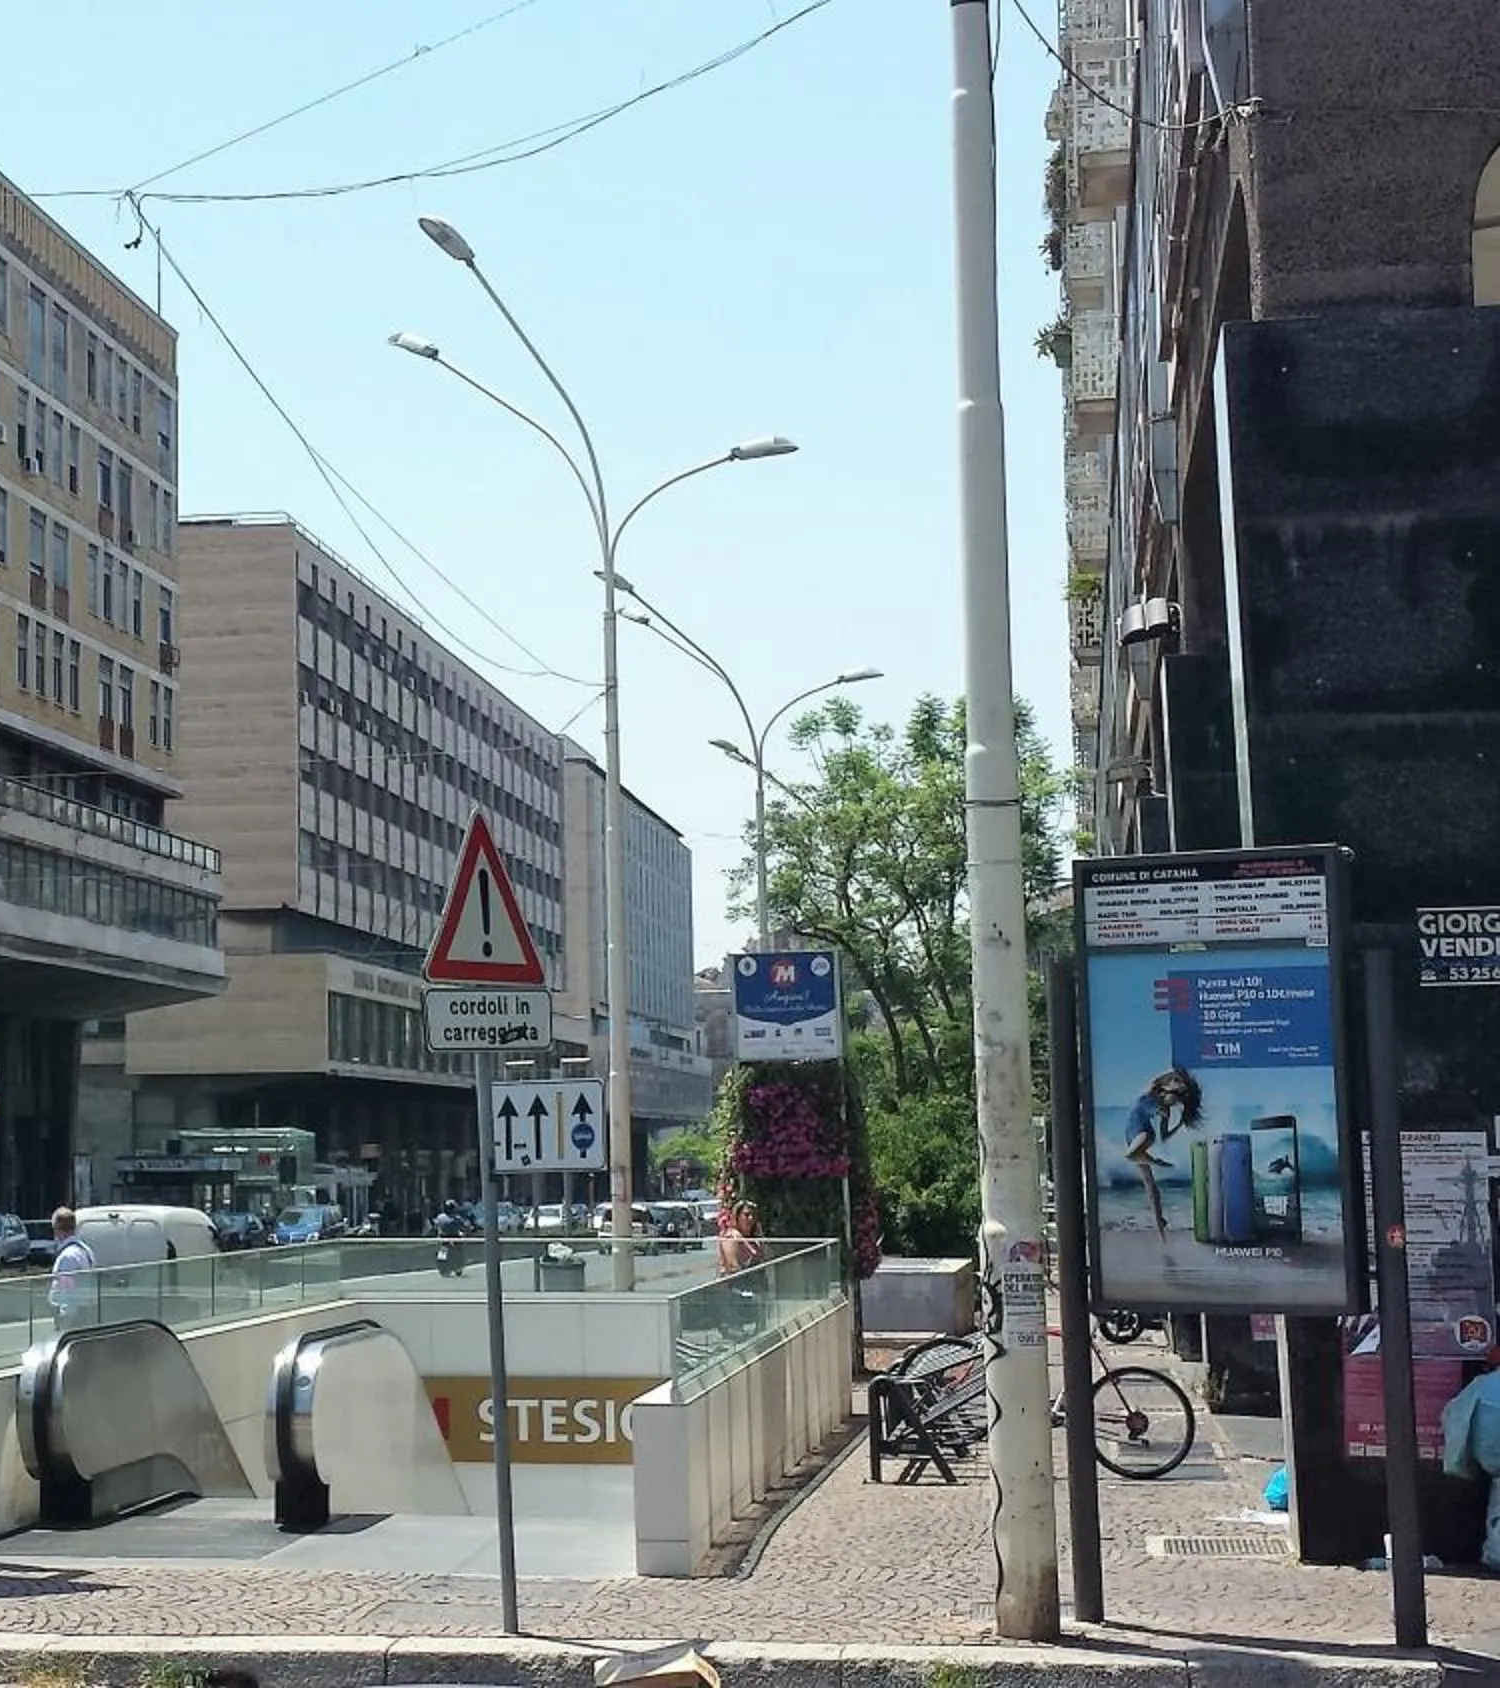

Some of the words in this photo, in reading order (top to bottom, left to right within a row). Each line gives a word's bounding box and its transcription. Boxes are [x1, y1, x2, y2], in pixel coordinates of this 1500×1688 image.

[1092, 871, 1137, 883] COMUNE
[1139, 871, 1151, 881] DI
[1153, 868, 1199, 879] CATANIA
[1418, 913, 1500, 934] GIORG
[1237, 989, 1257, 1000] P10
[449, 995, 509, 1015] cordoli
[515, 995, 531, 1015] in
[443, 1020, 539, 1045] carreggta
[1215, 1042, 1241, 1056] TIM
[1214, 1247, 1263, 1257] HUAWEI
